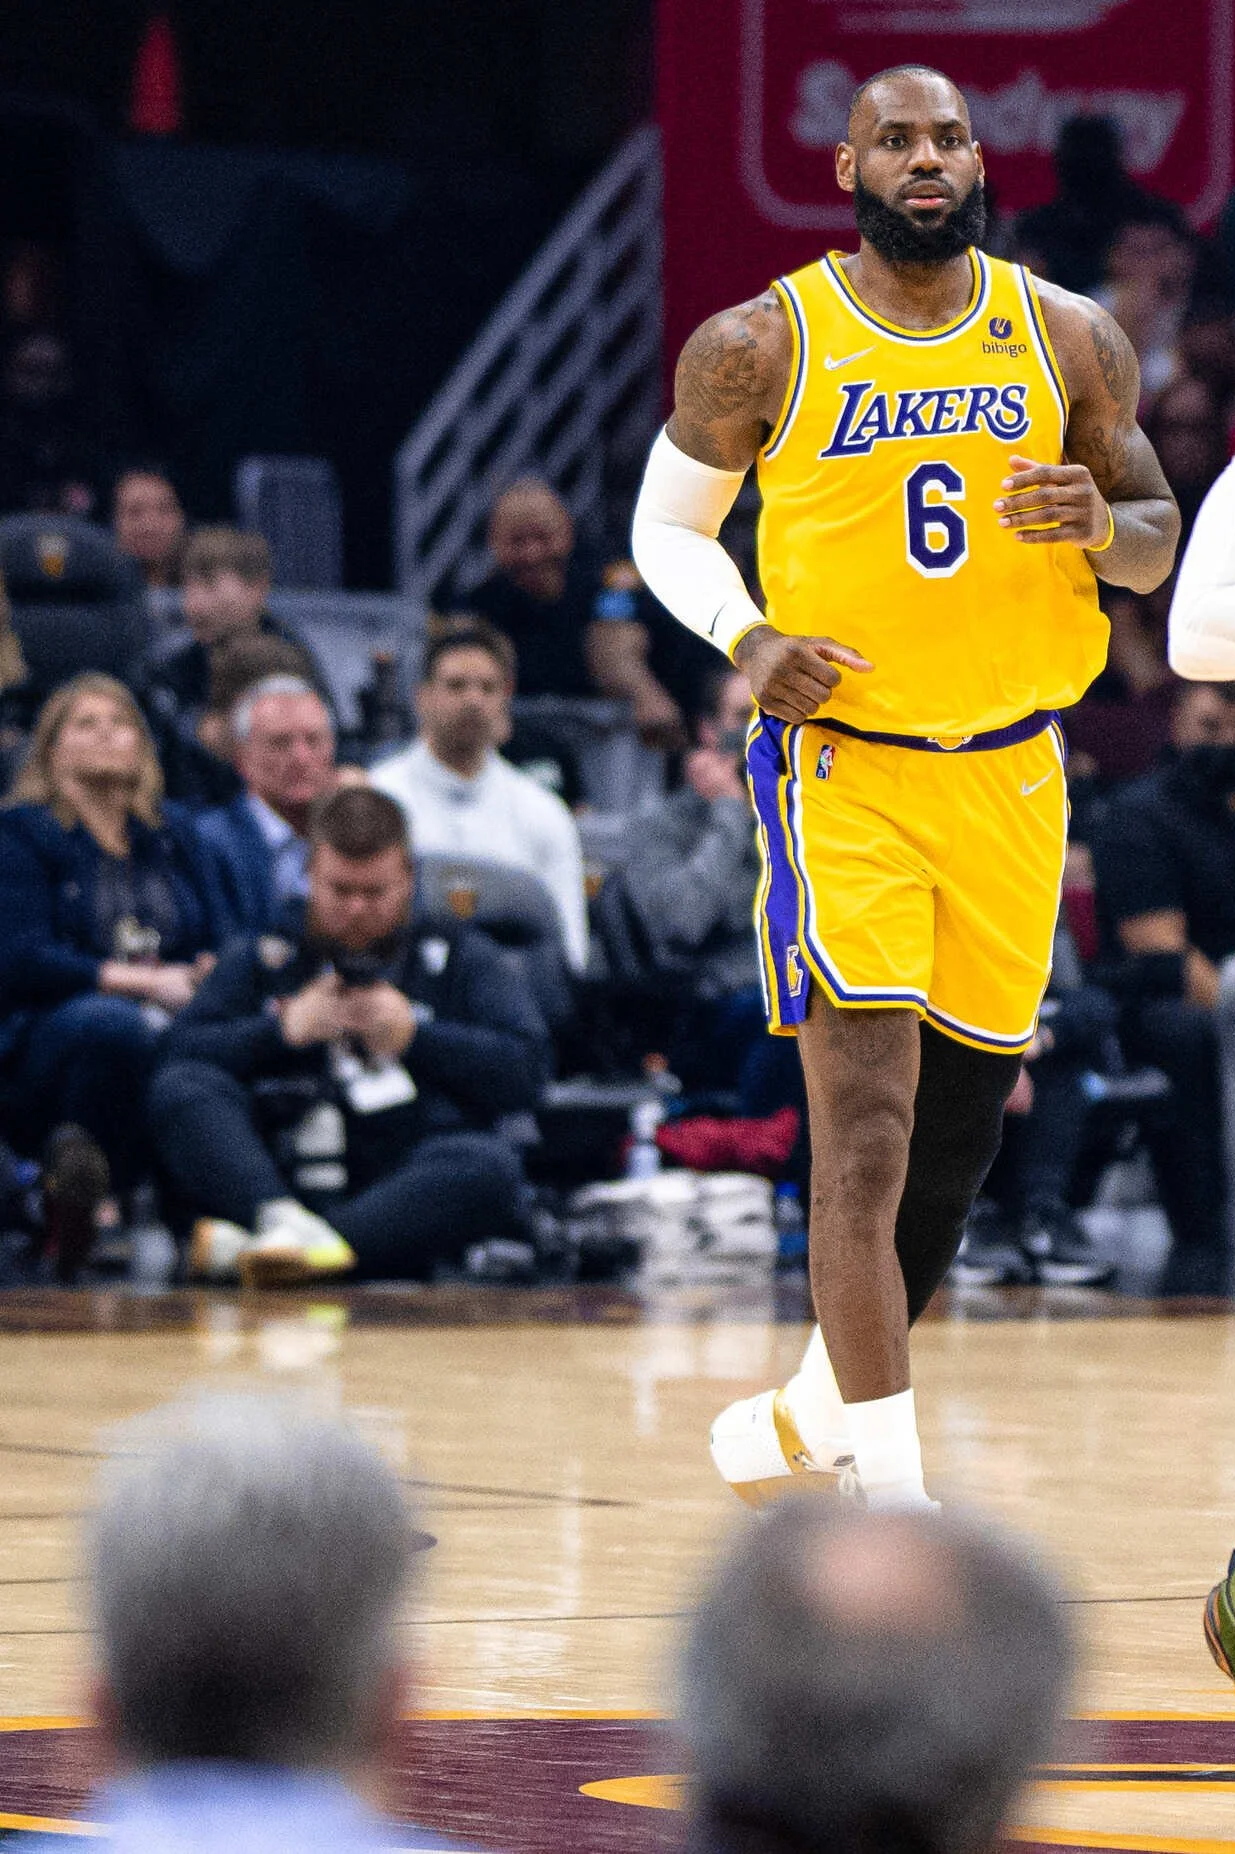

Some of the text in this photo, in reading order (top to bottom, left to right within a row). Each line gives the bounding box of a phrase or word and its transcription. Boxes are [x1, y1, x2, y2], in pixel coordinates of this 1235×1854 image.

[982, 341, 1027, 358] bibigo
[817, 380, 1031, 460] LAKERS
[906, 461, 968, 578] 6
